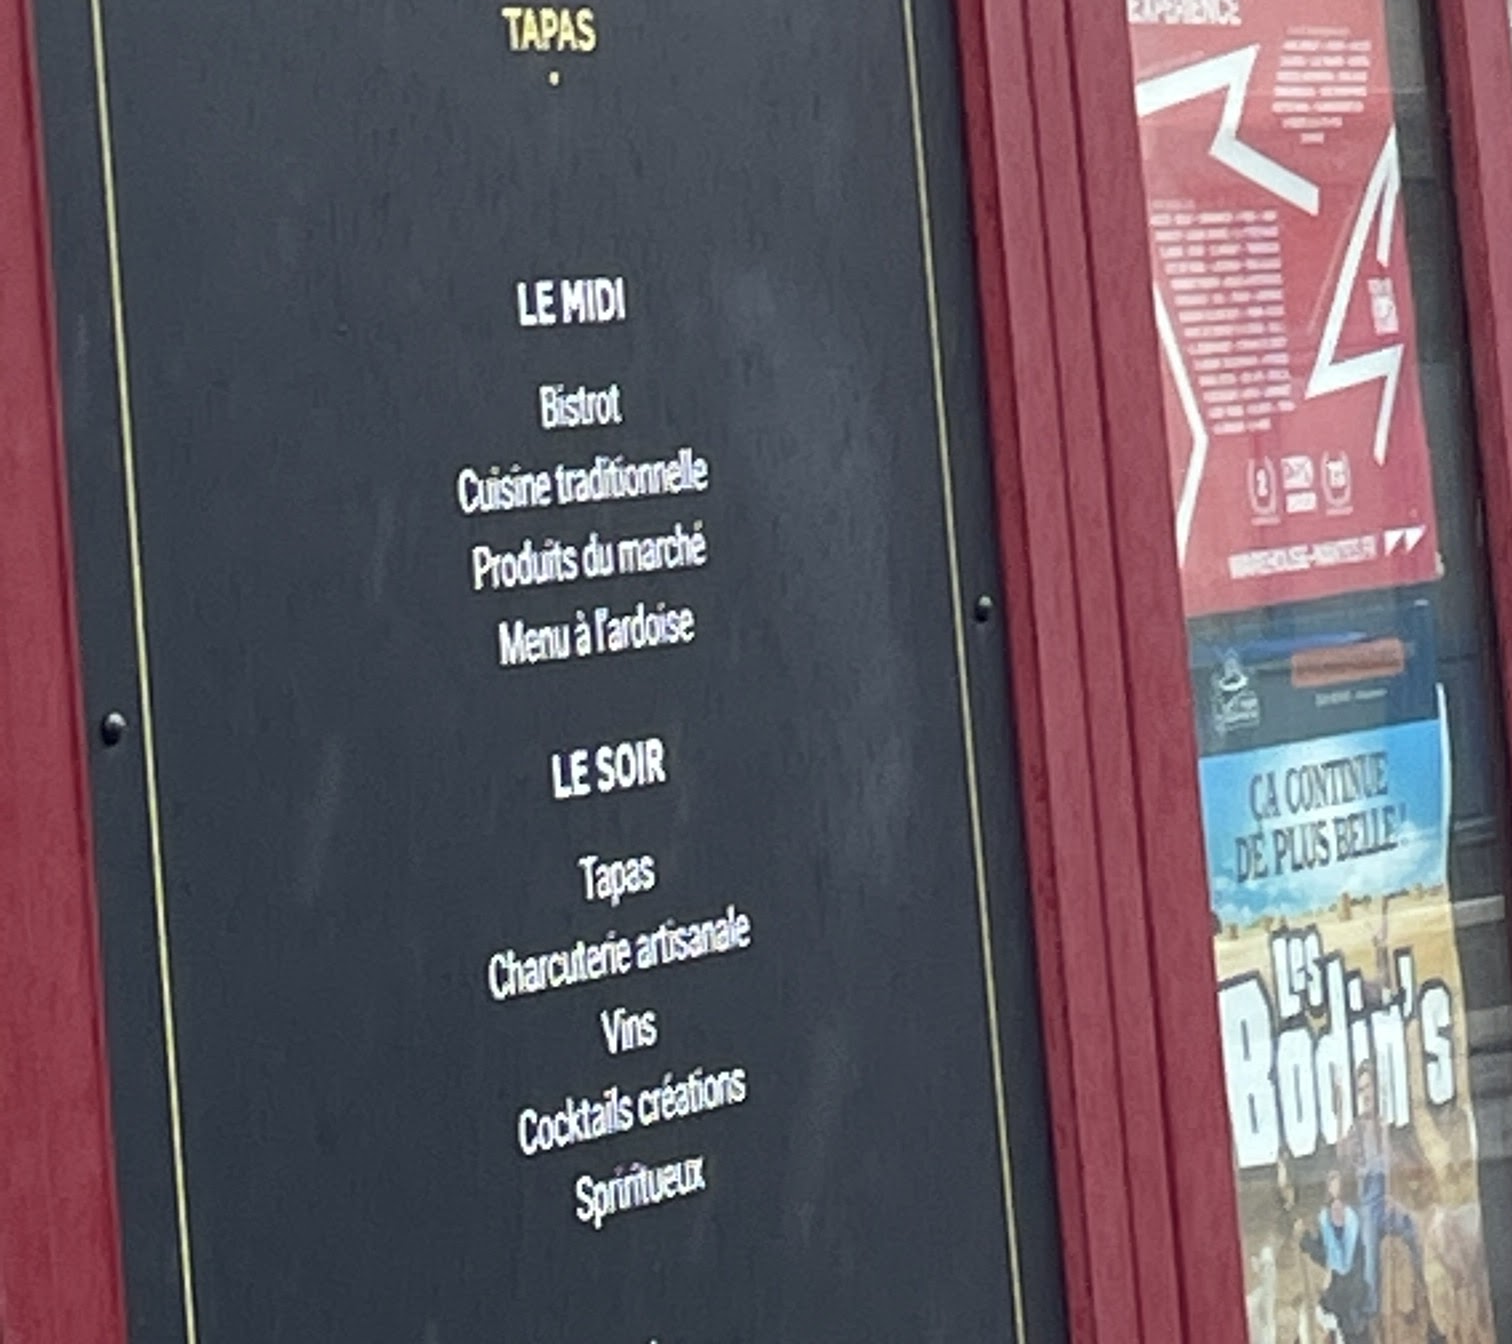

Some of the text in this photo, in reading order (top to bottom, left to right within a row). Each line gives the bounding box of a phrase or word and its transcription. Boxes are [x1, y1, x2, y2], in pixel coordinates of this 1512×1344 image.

[502, 7, 597, 52] TAPAS
[517, 277, 626, 326] LE MIDI
[539, 383, 623, 429] Bistrot
[457, 447, 709, 514] Cuisine traditionnelle
[472, 520, 707, 590] Produits du marché
[498, 602, 695, 665] Menu à l'ardoise
[551, 737, 666, 799] LE SOIR
[1286, 751, 1388, 814] CONTINUE
[578, 855, 655, 906] Tapas
[1235, 833, 1268, 883] DE
[1273, 820, 1330, 875] PLUS
[488, 905, 751, 1000] Charcuterie artisanale
[601, 1007, 658, 1054] Vins
[1216, 948, 1456, 1170] Bodin's
[518, 1068, 746, 1156] Cocktails créations
